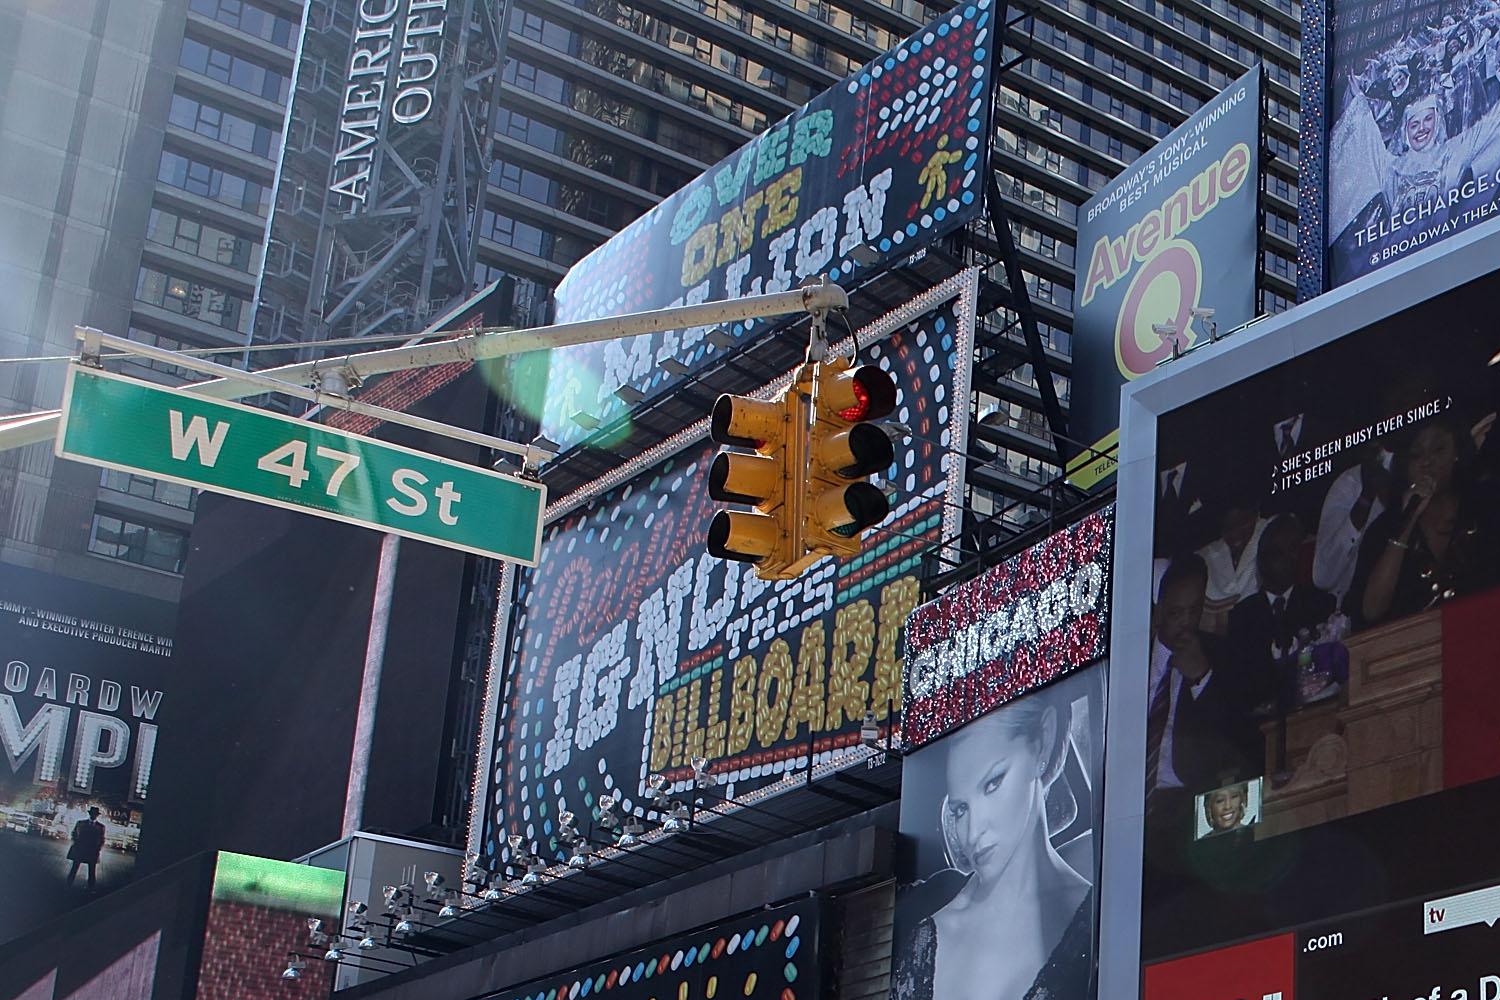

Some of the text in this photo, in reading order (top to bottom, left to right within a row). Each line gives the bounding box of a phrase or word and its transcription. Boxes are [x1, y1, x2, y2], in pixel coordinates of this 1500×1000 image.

[670, 109, 834, 246] OVER
[1087, 159, 1155, 223] BROADWAY'S
[1119, 137, 1208, 213] BEST MUSICAL
[681, 168, 802, 287] ONE
[1081, 143, 1250, 307] Avenue
[1383, 217, 1459, 261] BROADWAY
[1114, 239, 1201, 381] Q
[169, 410, 461, 526] W 47 St
[1282, 399, 1441, 473] SHE'S BEEN BUSY EVER SINCE
[1282, 460, 1332, 490] IT'S BEEN
[19, 616, 137, 650] AND EXECUTIVE PRODUCER
[80, 619, 154, 643] WRITER TERENCE
[725, 563, 834, 659] THIS
[4, 660, 164, 720] OARDW
[1303, 931, 1343, 951] .com
[1428, 906, 1444, 923] tv
